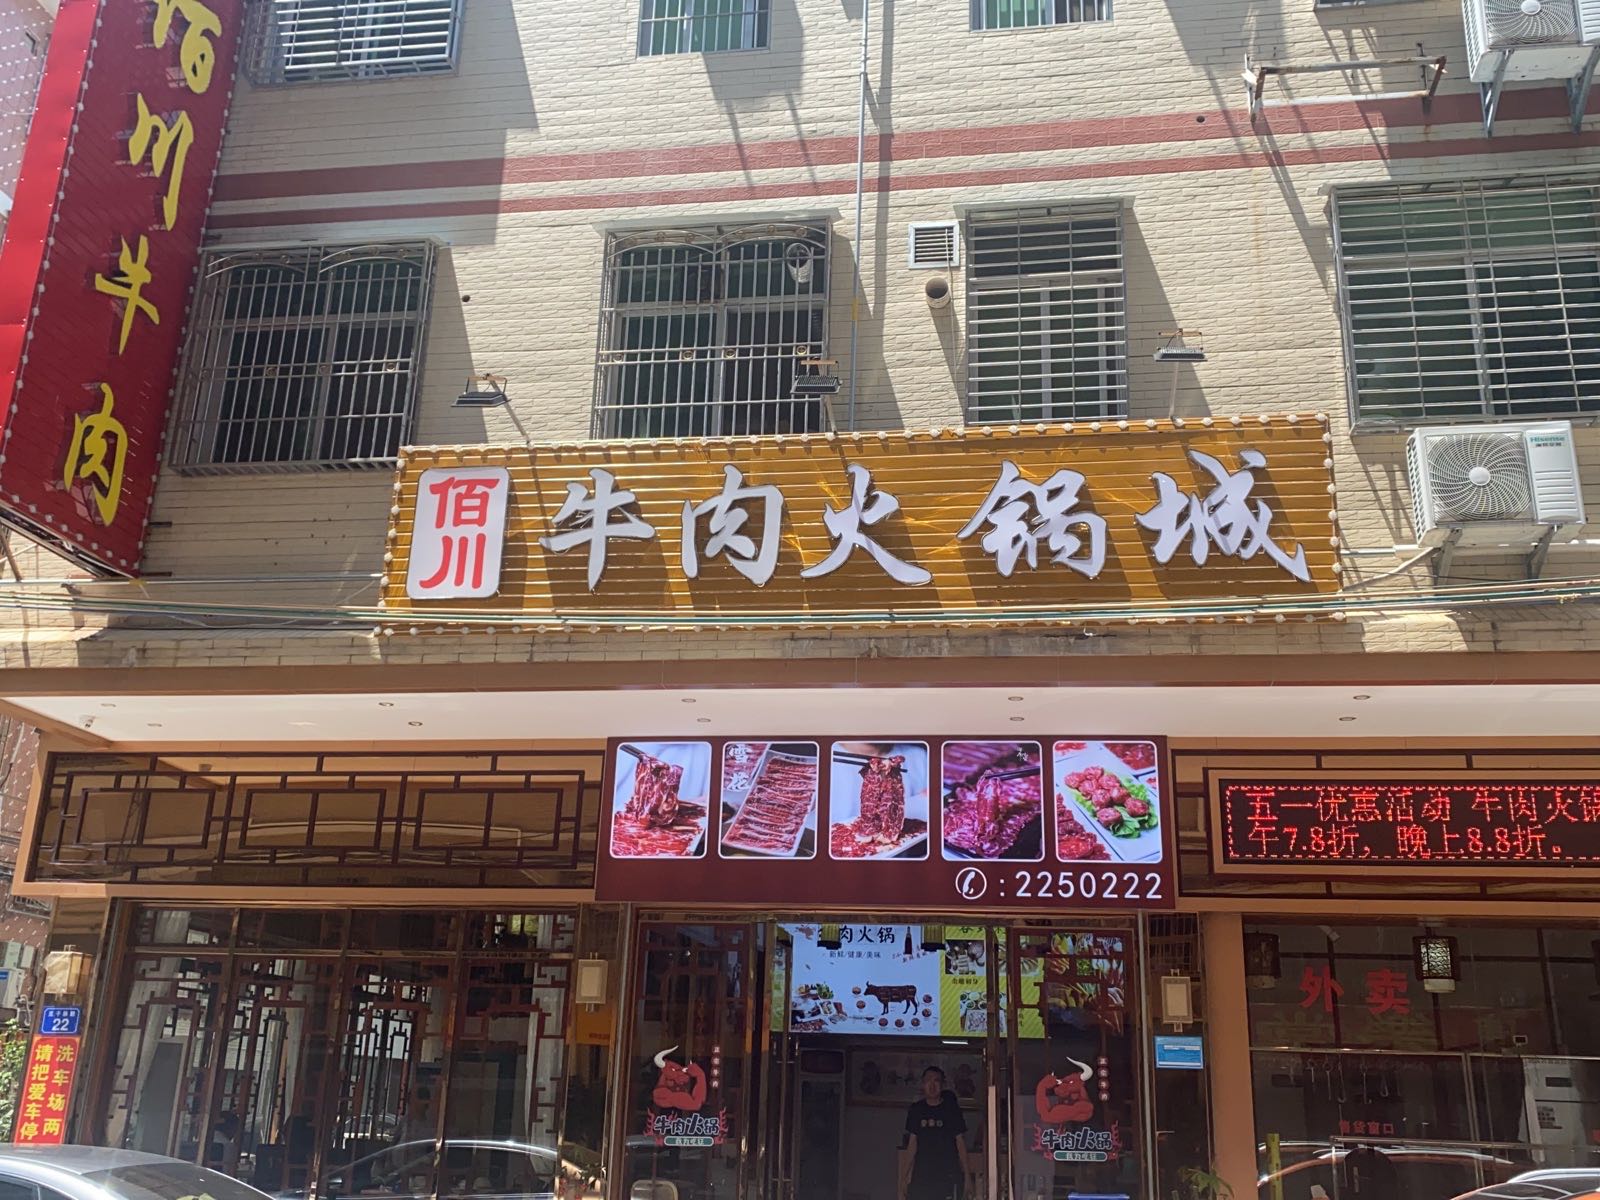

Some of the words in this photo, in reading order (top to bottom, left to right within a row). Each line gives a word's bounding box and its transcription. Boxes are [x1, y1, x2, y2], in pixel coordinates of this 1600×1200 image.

[419, 476, 499, 589] 佰川
[538, 447, 1311, 590] 牛肉火锅城
[1246, 790, 1451, 823] 五一优惠活动
[820, 924, 895, 944] 肉火锅
[1300, 965, 1410, 1015] 外卖
[51, 1018, 70, 1031] 22
[43, 1044, 75, 1136] 洗车场两
[654, 1113, 720, 1135] 牛肉火锅
[1042, 1127, 1113, 1150] 牛肉火锅
